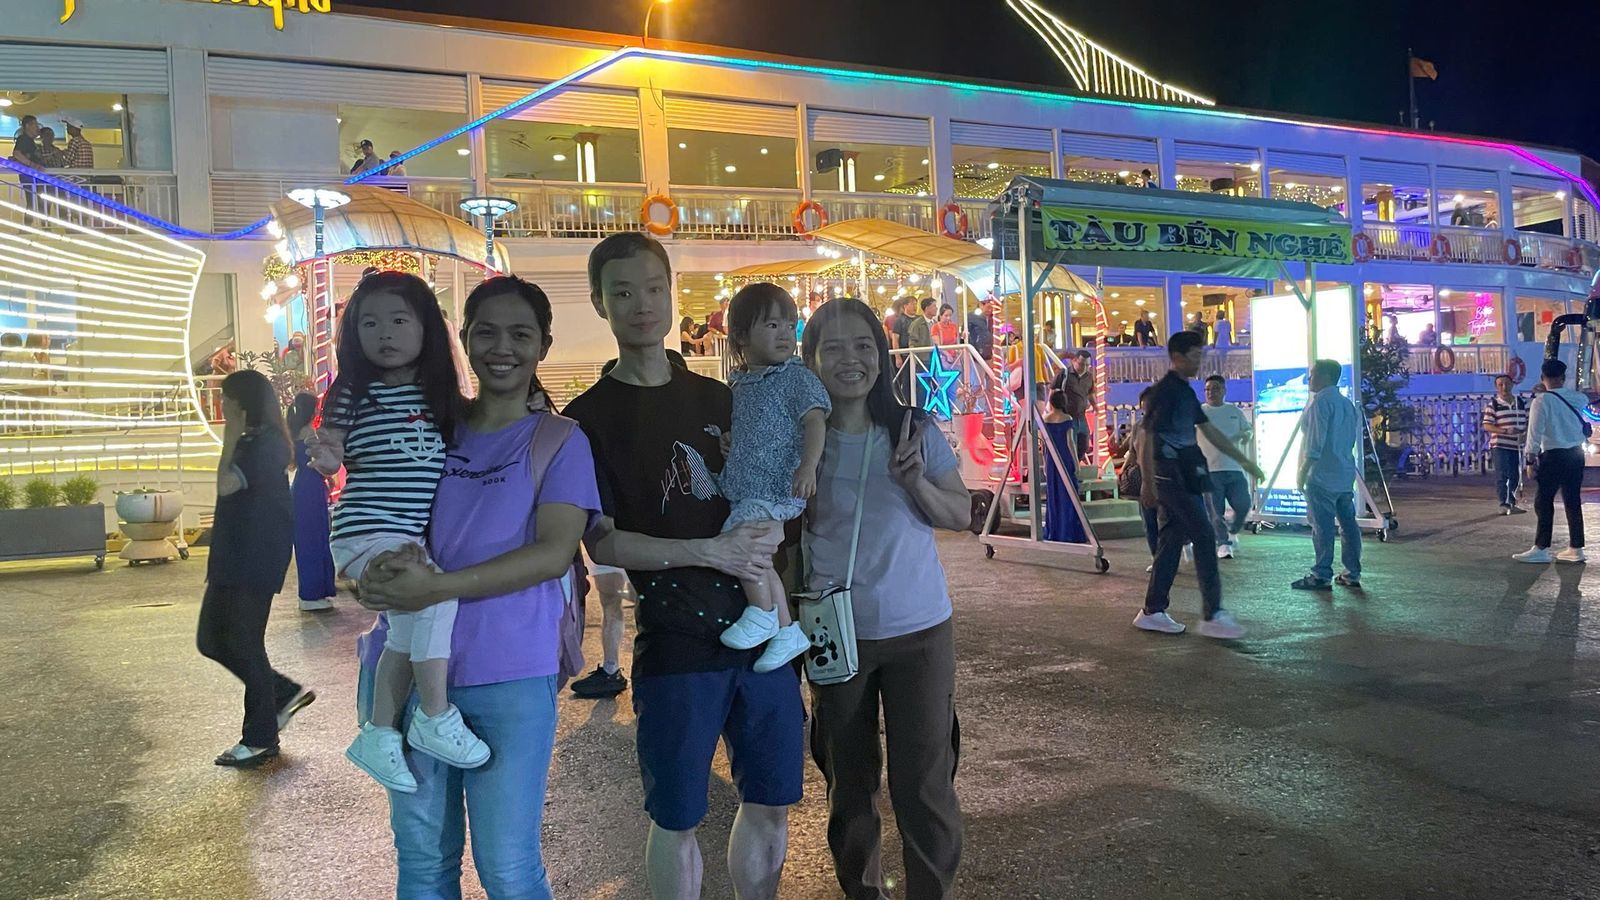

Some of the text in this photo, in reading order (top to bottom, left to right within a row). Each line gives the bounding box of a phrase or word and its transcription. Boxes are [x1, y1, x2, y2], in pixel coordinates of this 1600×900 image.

[1050, 215, 1148, 246] TÀU
[1246, 232, 1347, 260] NGHÉ
[482, 476, 506, 487] BOOK
